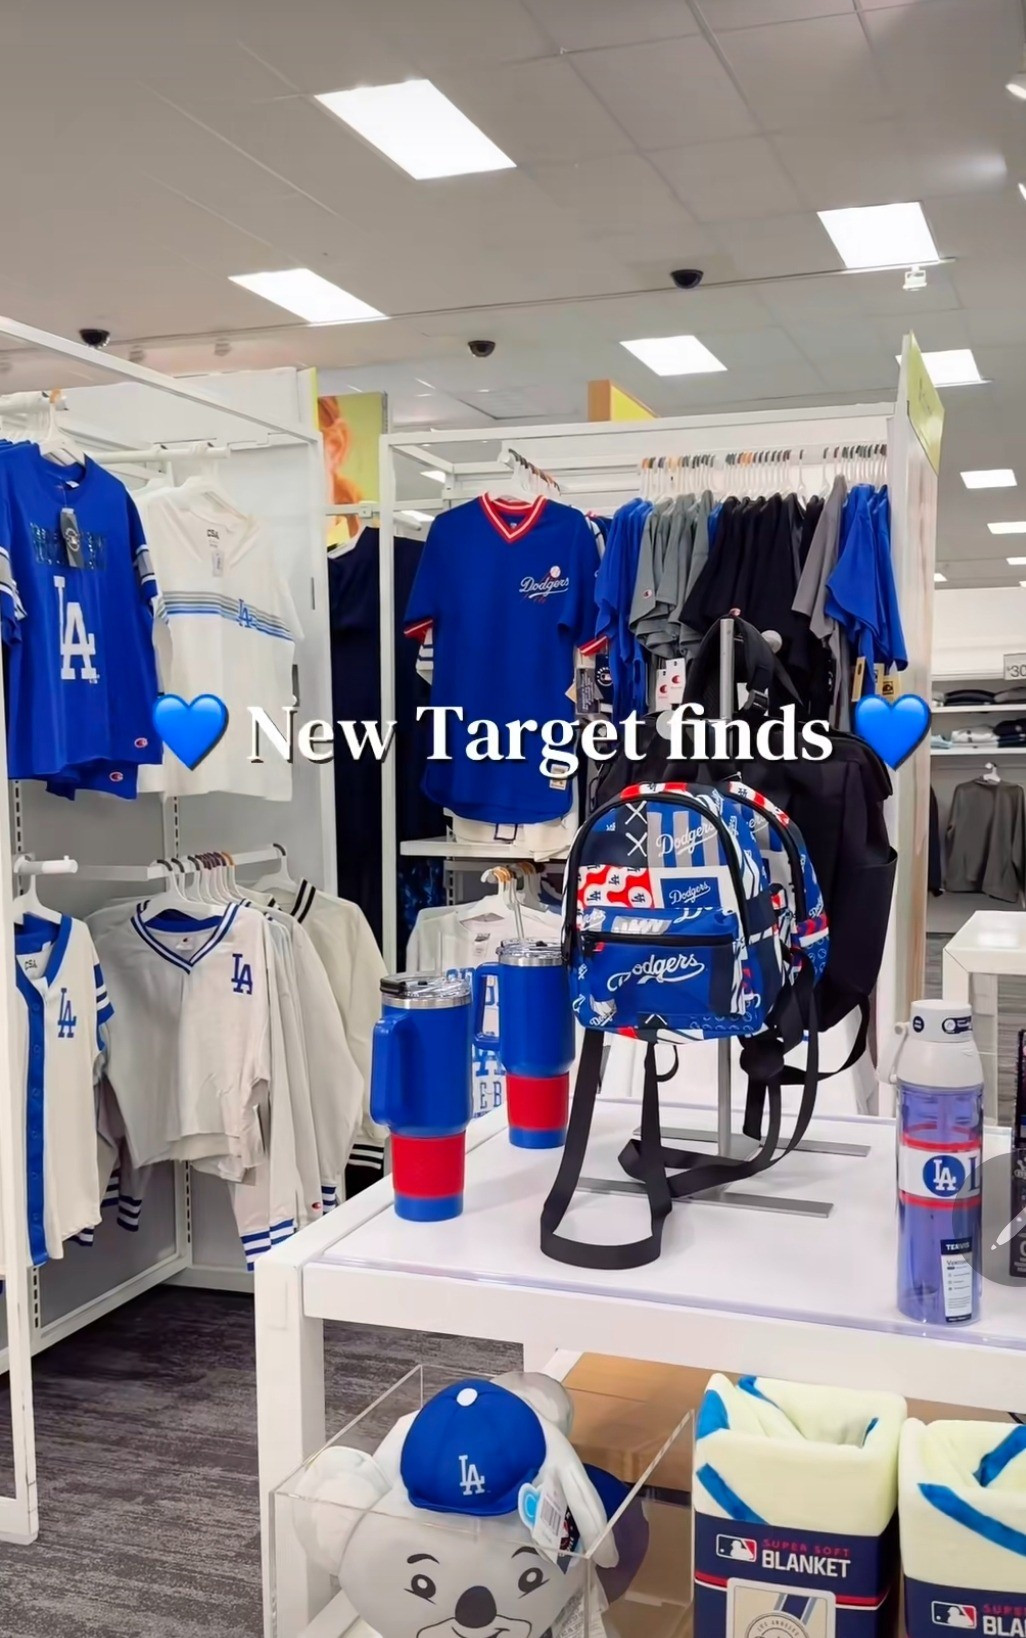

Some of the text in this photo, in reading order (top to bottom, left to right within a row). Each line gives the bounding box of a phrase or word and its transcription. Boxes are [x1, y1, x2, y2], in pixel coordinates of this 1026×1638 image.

[518, 576, 570, 599] Dodgers
[53, 575, 96, 680] LA
[236, 598, 254, 628] LA
[669, 880, 711, 905] Dodgers
[231, 952, 253, 995] LA
[57, 987, 76, 1037] LA
[933, 1158, 957, 1191] LA
[458, 1454, 486, 1496] LA
[763, 1538, 850, 1557] SUPER SOFT
[762, 1549, 851, 1578] BLANKET
[983, 1603, 1026, 1617] SUPE
[983, 1615, 1026, 1638] BLA
